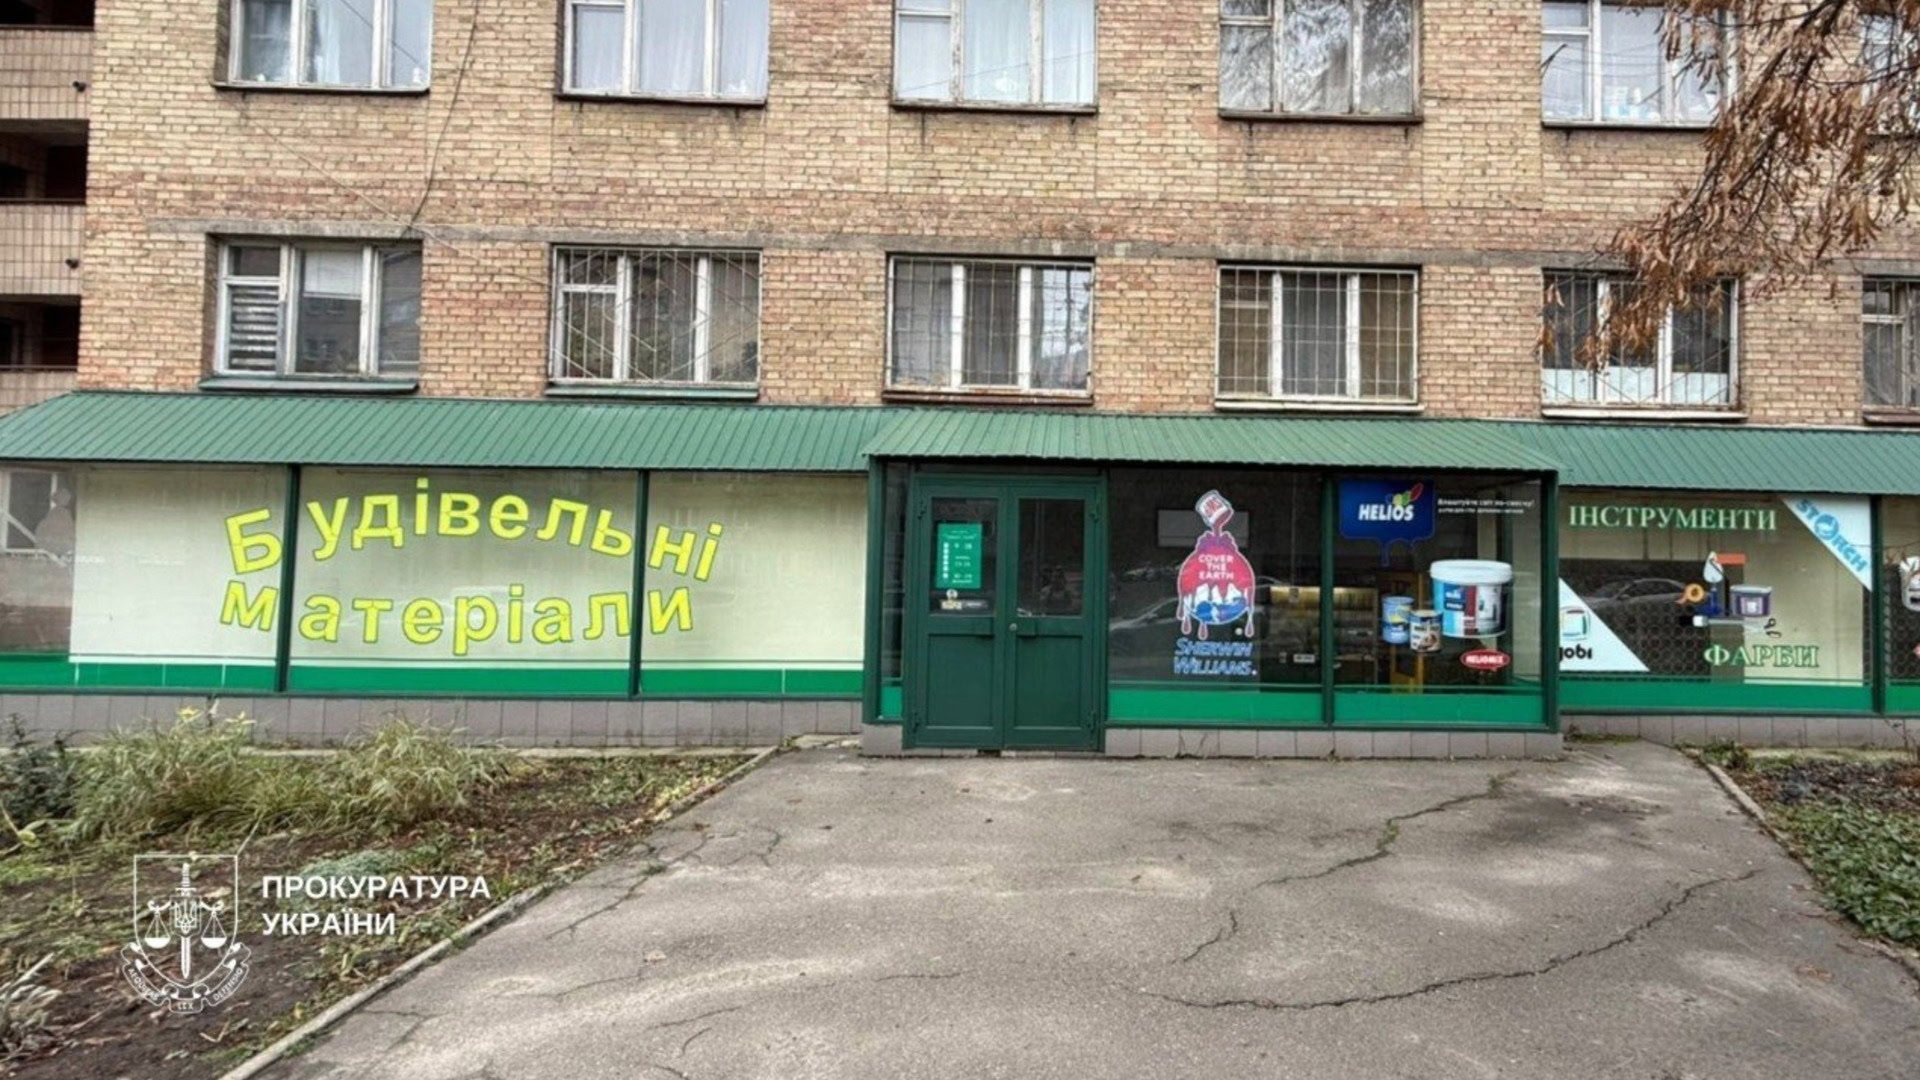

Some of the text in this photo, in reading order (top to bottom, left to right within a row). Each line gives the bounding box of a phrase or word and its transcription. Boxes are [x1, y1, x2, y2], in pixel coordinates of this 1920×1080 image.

[1358, 503, 1414, 521] HELIOS
[1569, 505, 1776, 530] ІНСТРУМЕНТИ
[225, 477, 725, 581] Будівельні
[1796, 499, 1868, 572] STORCH
[1199, 554, 1233, 563] COVER
[1207, 563, 1227, 572] THE
[1199, 571, 1234, 580] EARTH
[220, 581, 693, 656] матеріали
[1175, 637, 1253, 656] SHERWIN
[1704, 645, 1820, 667] ФАРБИ
